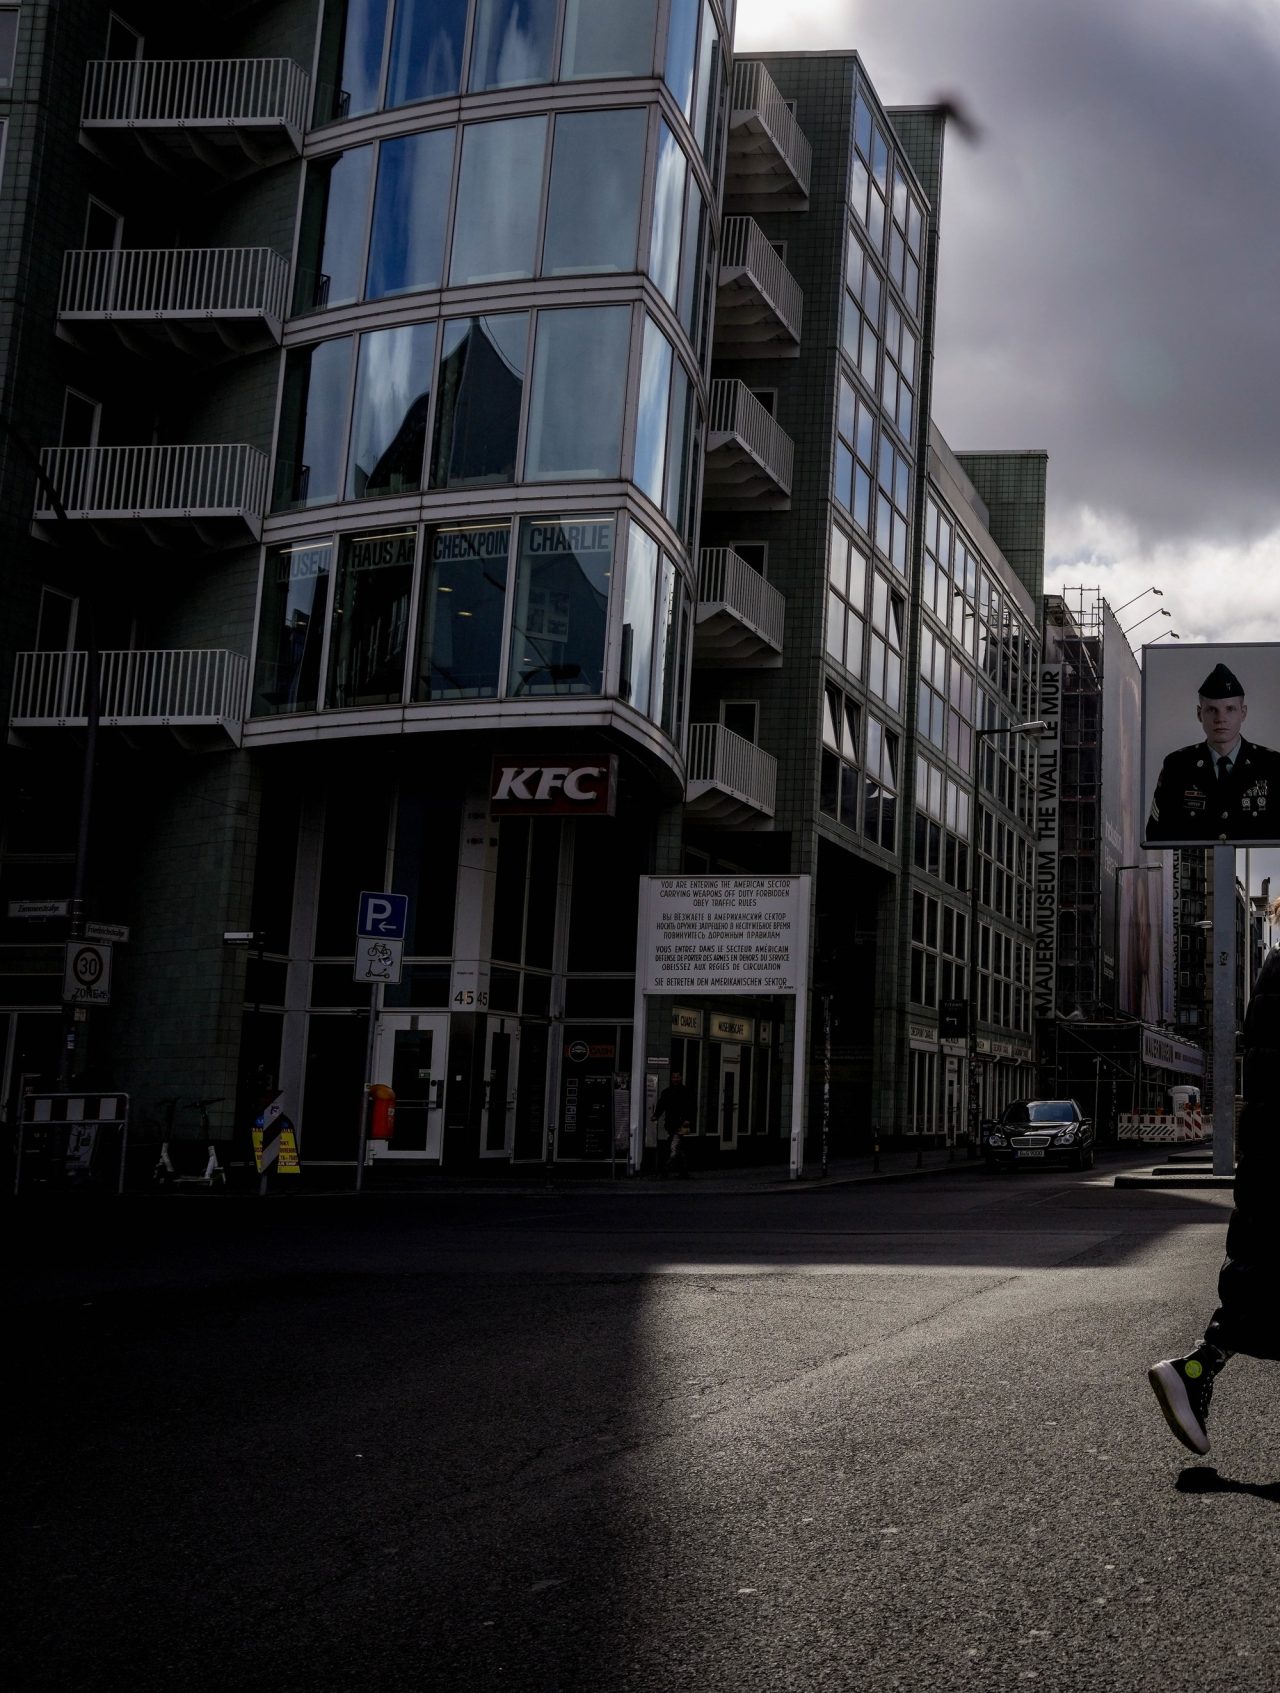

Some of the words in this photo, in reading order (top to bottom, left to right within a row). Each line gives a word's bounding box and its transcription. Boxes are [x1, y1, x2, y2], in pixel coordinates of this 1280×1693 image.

[278, 549, 331, 580] MUSEU
[351, 541, 393, 568] HAUS
[433, 531, 510, 560] CHECKPOIN
[529, 525, 609, 553] CHARLIE
[1041, 671, 1060, 715] MUR
[1041, 721, 1059, 740] LE
[1039, 749, 1058, 803] WALL
[492, 767, 599, 801] KFC
[1038, 806, 1057, 841] THE
[661, 880, 673, 889] YOU
[676, 880, 687, 889] ARE
[690, 880, 718, 889] ENTERING
[720, 880, 731, 889] THE
[733, 880, 765, 889] AMERICAN
[768, 880, 791, 889] SECTOR
[660, 889, 691, 898] CARRYING
[693, 889, 722, 898] WEAPONS
[724, 889, 736, 898] OFF
[738, 889, 753, 898] DUTY
[756, 889, 790, 898] FORBIDDEN
[693, 898, 708, 907] OBEY
[712, 898, 736, 907] TRAFFIC
[738, 898, 757, 907] RULES
[366, 898, 393, 931] P
[764, 912, 786, 921] СЕКТОР
[1036, 851, 1056, 1010] MAUERMUSEUM
[656, 945, 672, 953] VOUS
[675, 945, 696, 953] ENTREZ
[699, 945, 715, 953] DANS
[726, 945, 753, 953] SECTEUR
[683, 954, 702, 962] PORTER
[703, 954, 713, 962] DES
[713, 954, 730, 962] ARMES
[739, 954, 759, 962] DEHORS
[768, 954, 790, 962] SERVICE
[79, 957, 97, 976] 30
[694, 963, 706, 971] AUX
[743, 963, 781, 971] CIRCULATION
[666, 977, 694, 987] BETRETEN
[697, 977, 708, 987] DEN
[711, 977, 762, 987] AMERIKANISCHEN
[764, 977, 787, 987] SEKTOR
[454, 990, 474, 1005] 45
[476, 991, 488, 1006] 45
